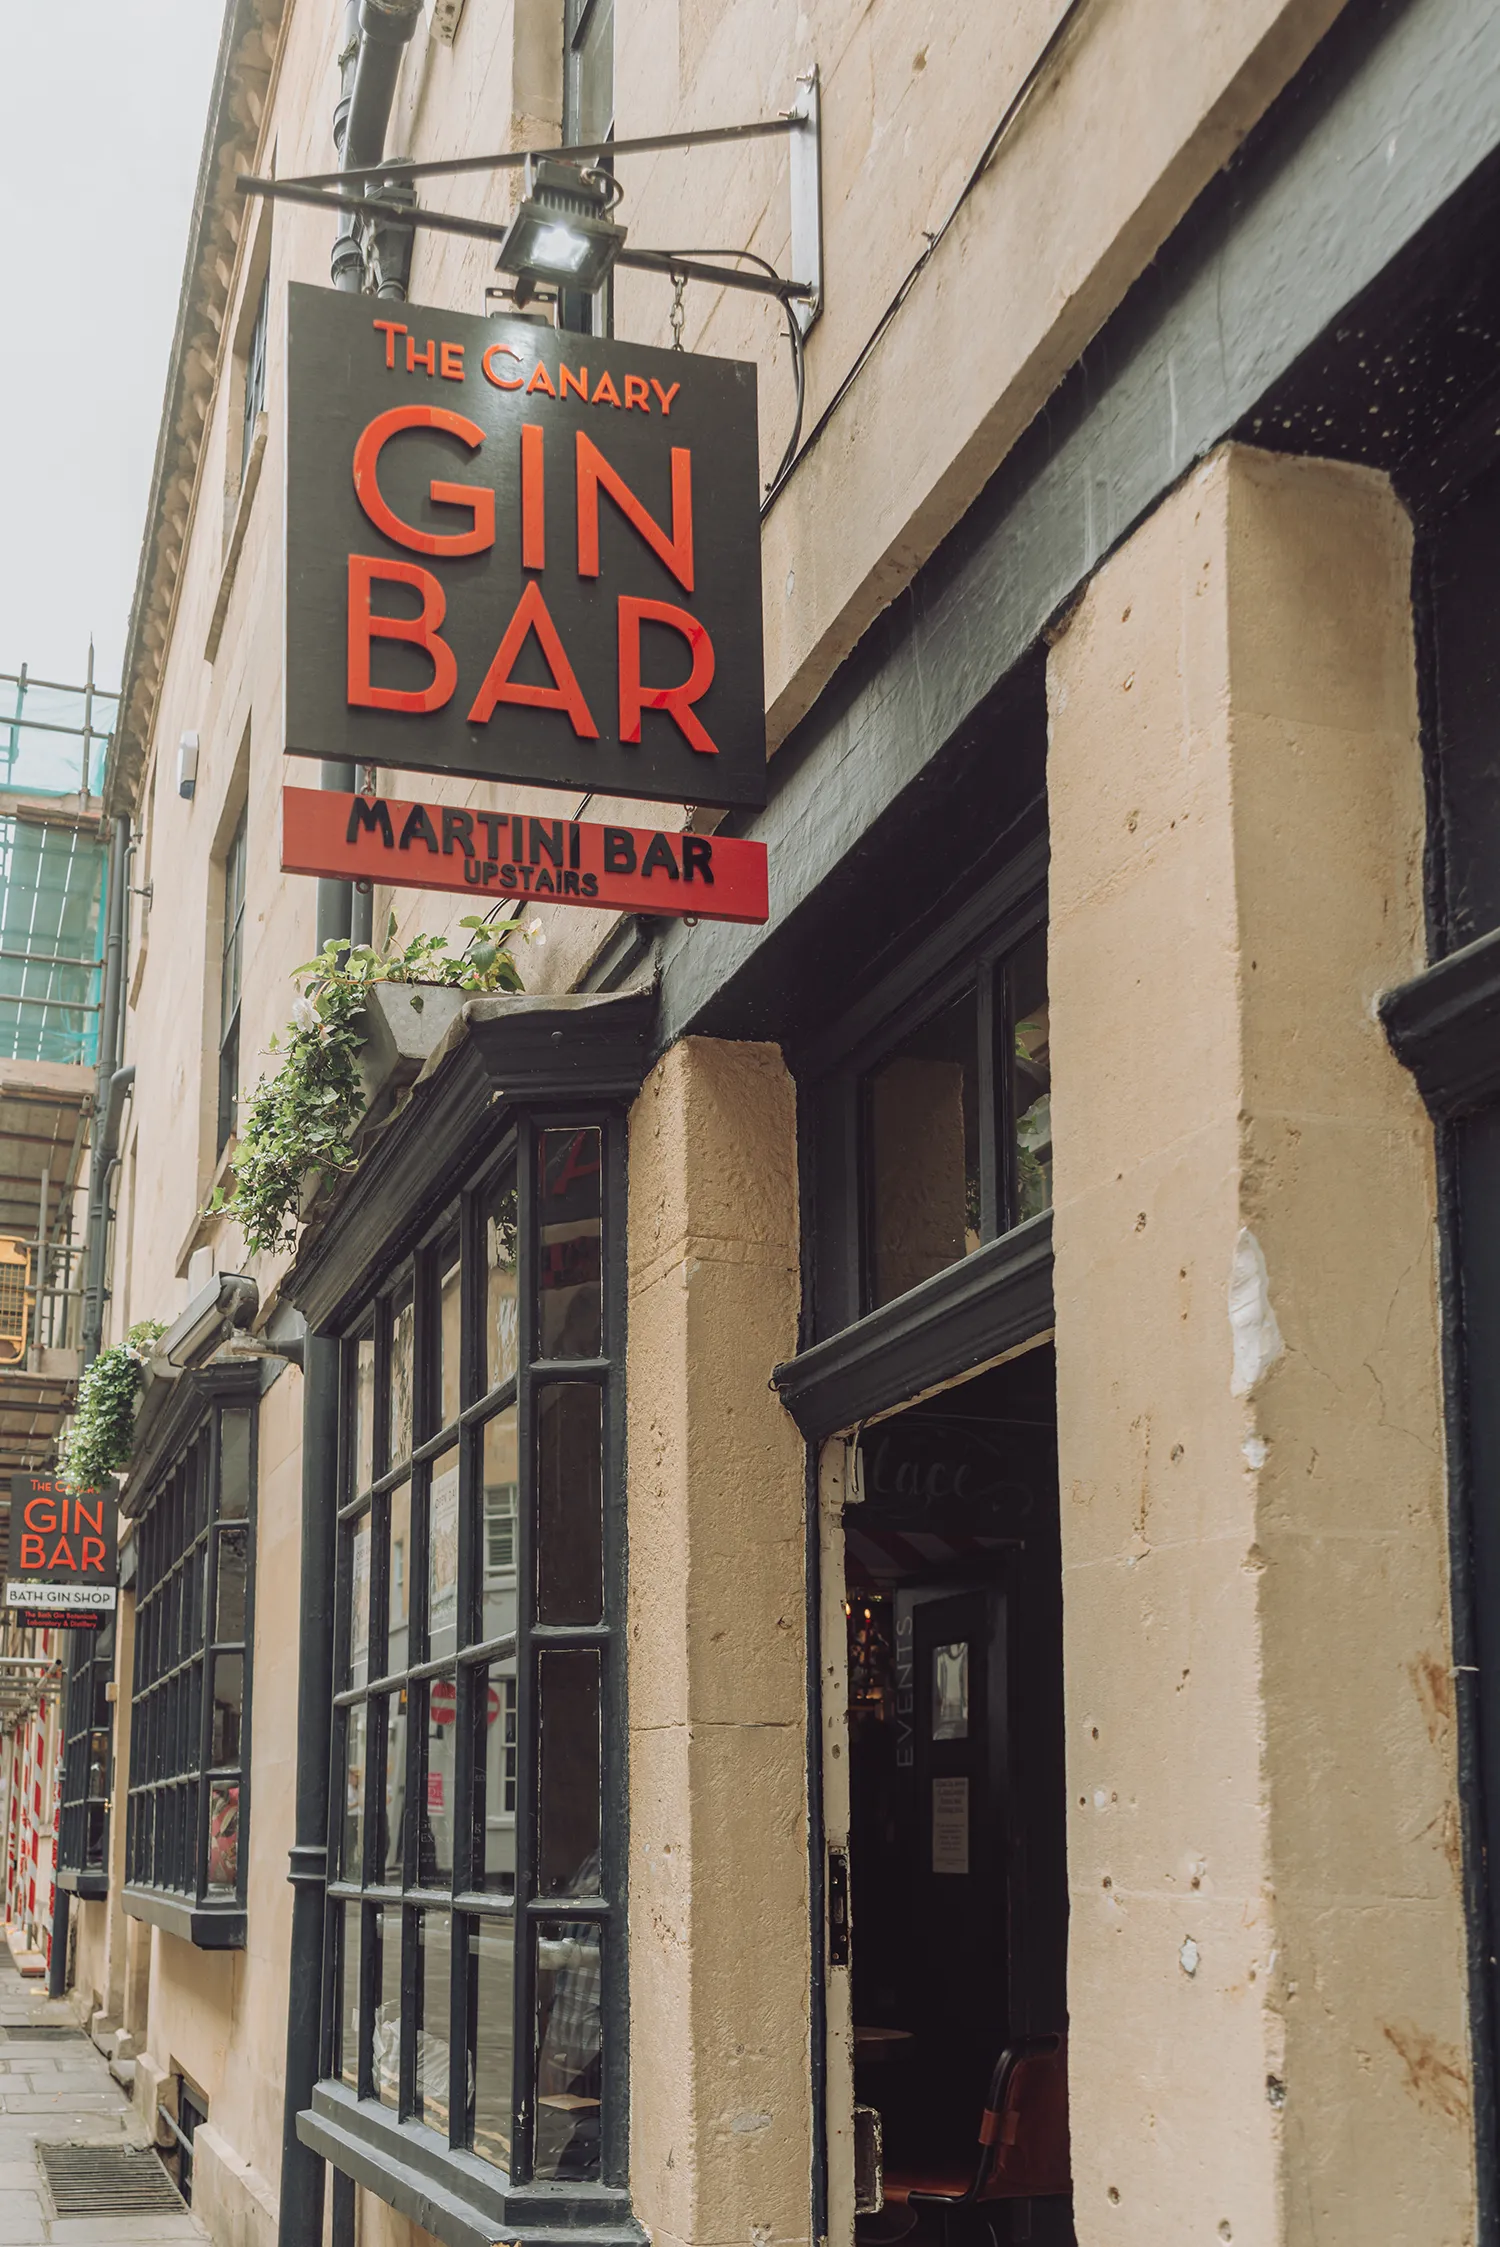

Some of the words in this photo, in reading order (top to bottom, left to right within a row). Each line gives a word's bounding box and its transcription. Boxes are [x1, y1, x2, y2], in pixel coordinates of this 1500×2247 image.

[353, 404, 695, 593] GIN
[347, 554, 719, 755] BAR
[346, 797, 581, 870] MARTINI
[604, 828, 715, 885] BAR
[464, 859, 599, 898] UPSTAIRS
[24, 1498, 104, 1535] GIN
[20, 1534, 105, 1572] BAR
[9, 1590, 43, 1602] BATH
[47, 1591, 71, 1602] GIN
[73, 1592, 111, 1604] SHOP
[24, 1610, 36, 1618] The
[37, 1611, 52, 1619] Bath
[26, 1618, 62, 1628] Laboratory
[70, 1620, 97, 1629] Distillery
[896, 1616, 914, 1767] EVENTS
